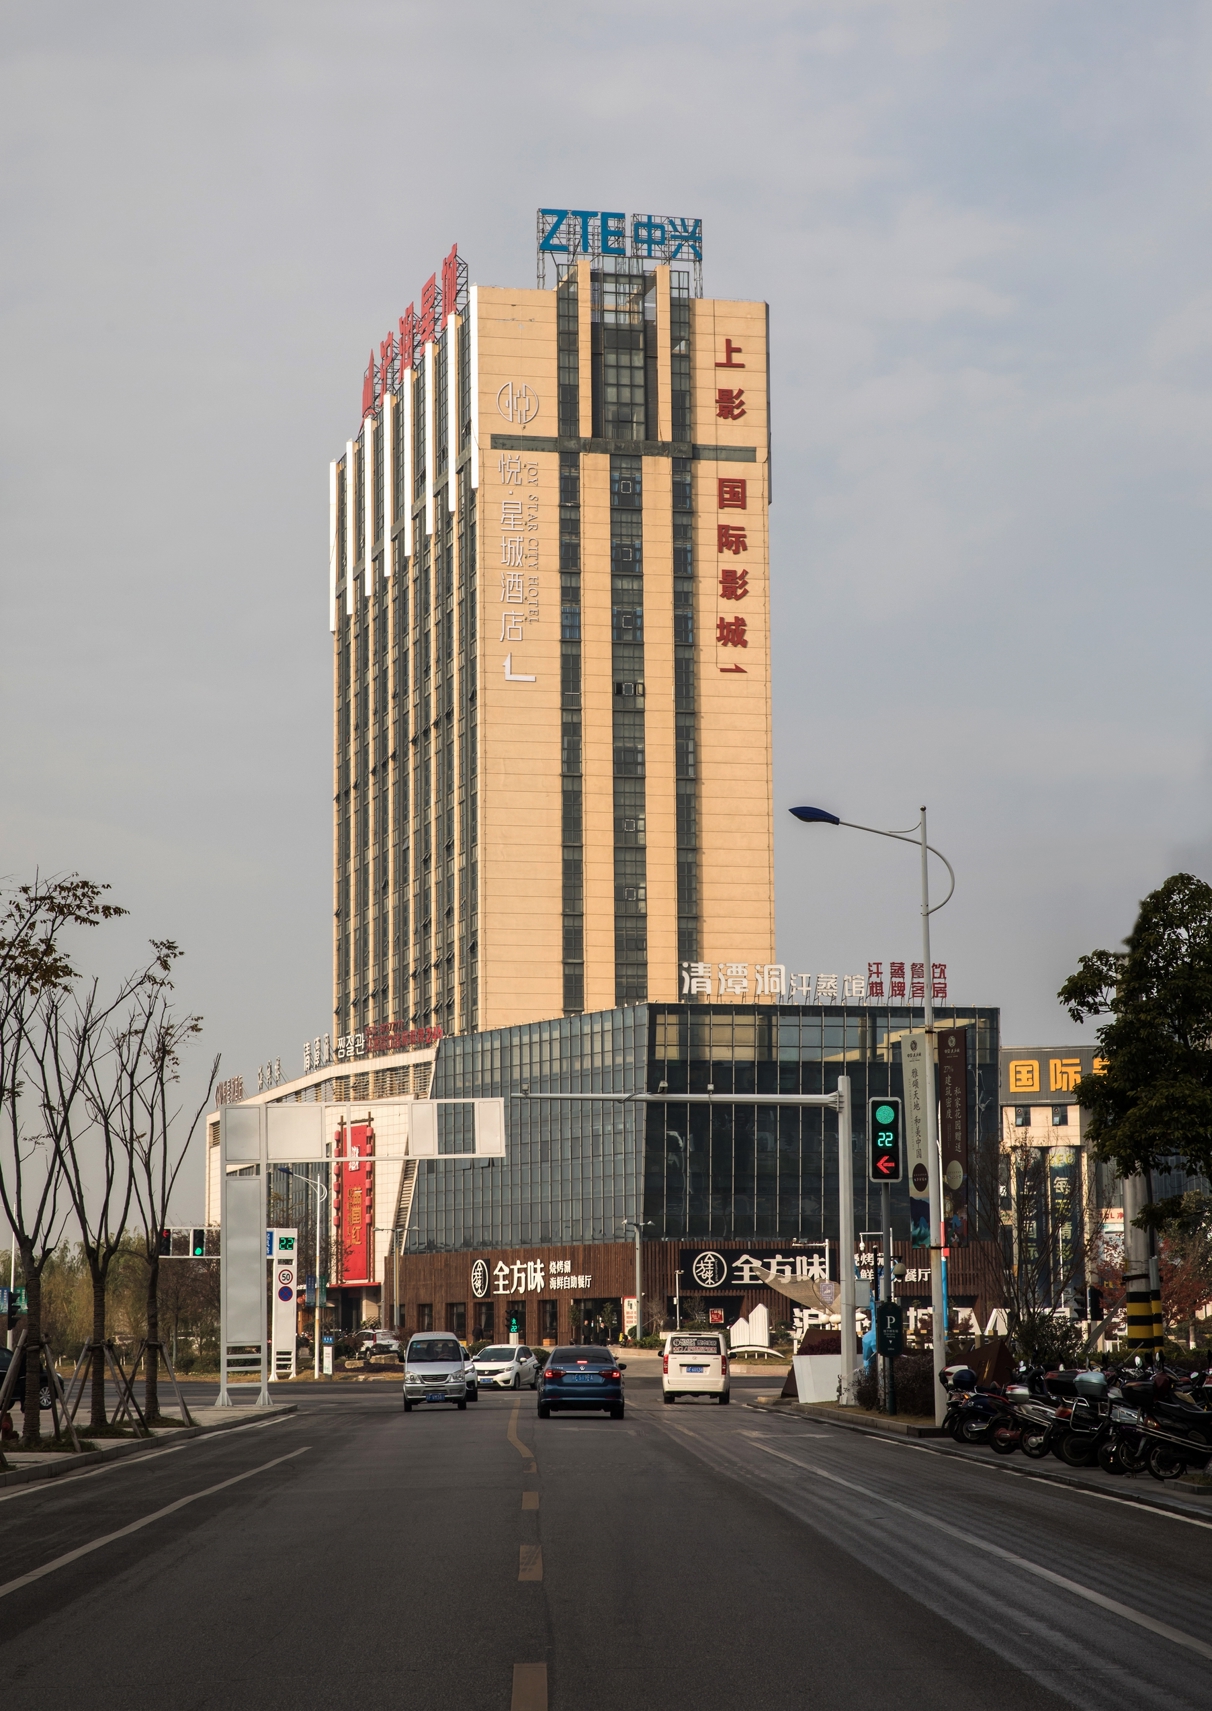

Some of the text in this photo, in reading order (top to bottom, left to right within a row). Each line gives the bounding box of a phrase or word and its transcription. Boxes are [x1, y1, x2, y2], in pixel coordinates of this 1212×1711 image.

[540, 208, 626, 255] ZTE
[634, 215, 703, 260] 中兴
[715, 338, 749, 649] 上影 国际影城
[526, 461, 540, 625] JOY STAR CITY HOTEL
[681, 961, 867, 997] 清潭洞 汗蒸馆
[868, 980, 948, 999] 棋牌客房
[877, 1132, 893, 1147] 22
[278, 1237, 294, 1250] 22
[281, 1273, 291, 1282] 50
[493, 1258, 545, 1295] 全方味
[549, 1274, 592, 1290] 海鲜自助餐厅
[731, 1253, 827, 1284] 全方味
[886, 1315, 896, 1329] P
